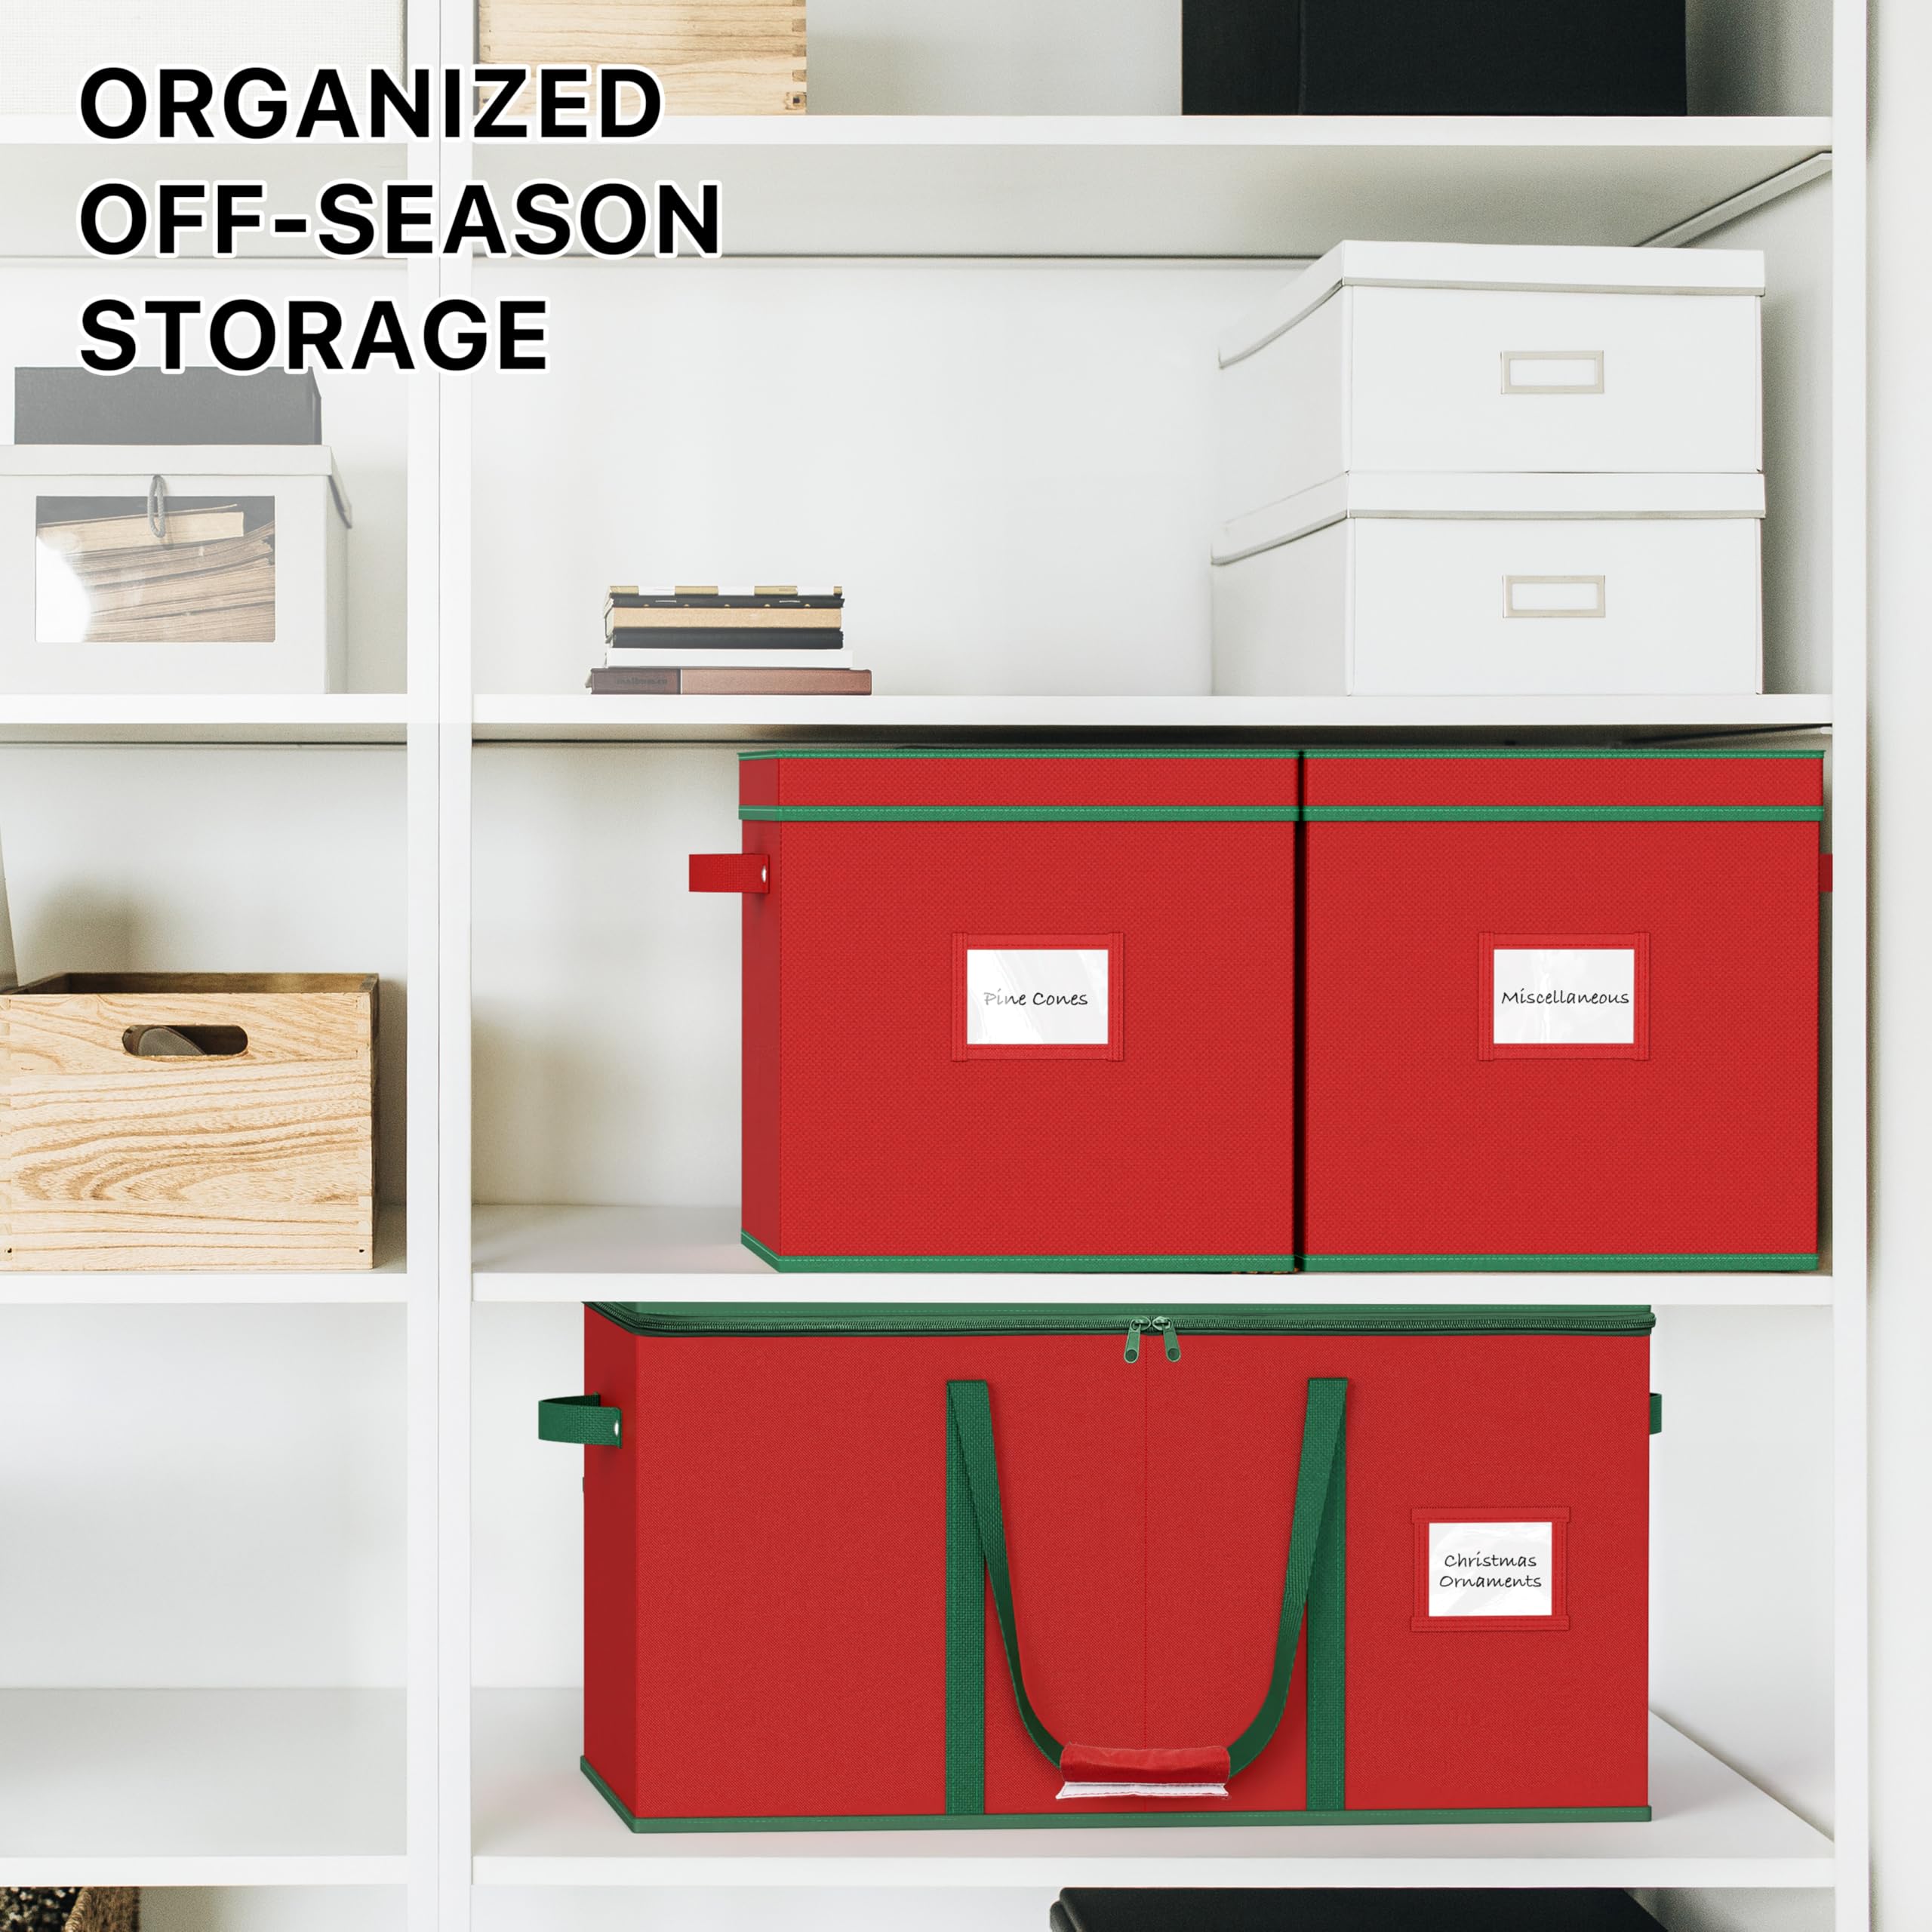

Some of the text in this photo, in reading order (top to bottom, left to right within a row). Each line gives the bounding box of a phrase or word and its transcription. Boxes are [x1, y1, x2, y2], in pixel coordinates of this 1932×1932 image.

[984, 989, 1088, 1005] Pine Cones
[1502, 988, 1629, 1004] Miscellaneous
[1444, 1552, 1537, 1567] Christmas
[1440, 1575, 1542, 1588] Ornaments
